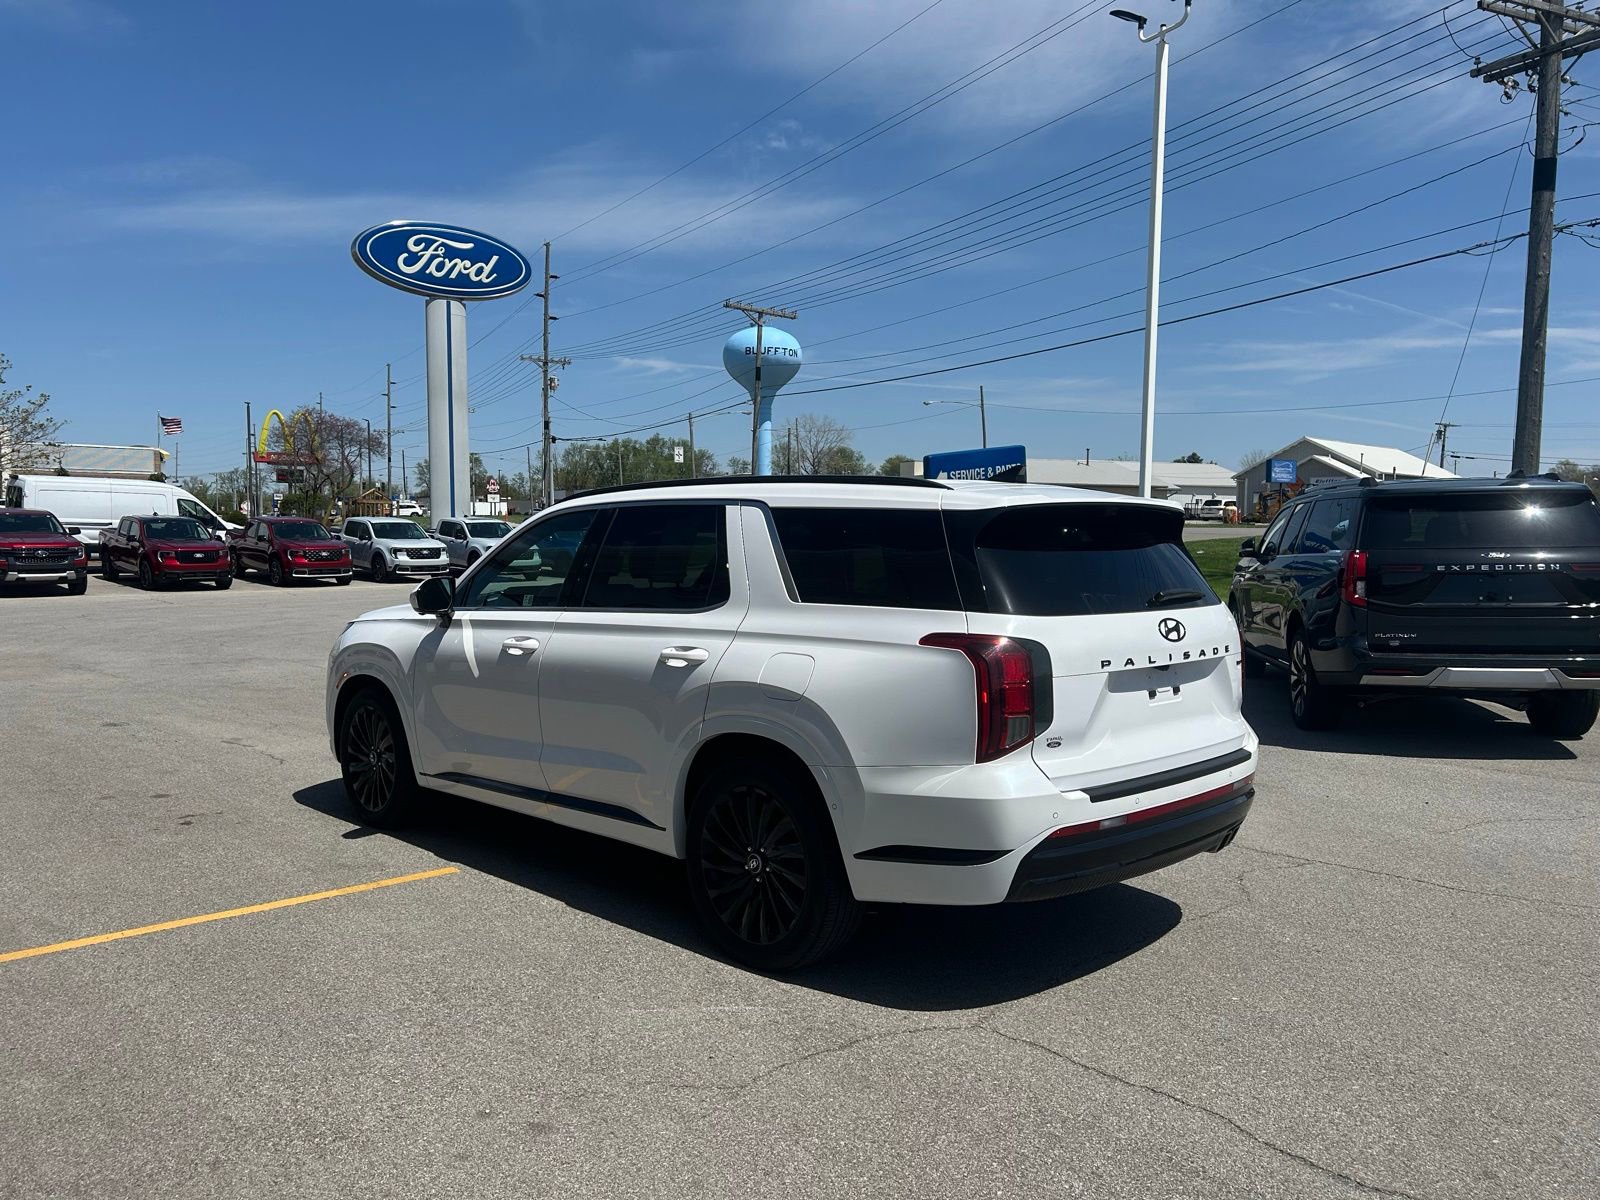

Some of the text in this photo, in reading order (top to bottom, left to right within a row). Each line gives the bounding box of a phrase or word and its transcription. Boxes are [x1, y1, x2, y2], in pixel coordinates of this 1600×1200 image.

[397, 234, 499, 283] Ford
[745, 346, 798, 358] BLUFFTON
[950, 467, 986, 480] SERVICE
[987, 466, 994, 478] &
[1100, 645, 1230, 669] PALISADE
